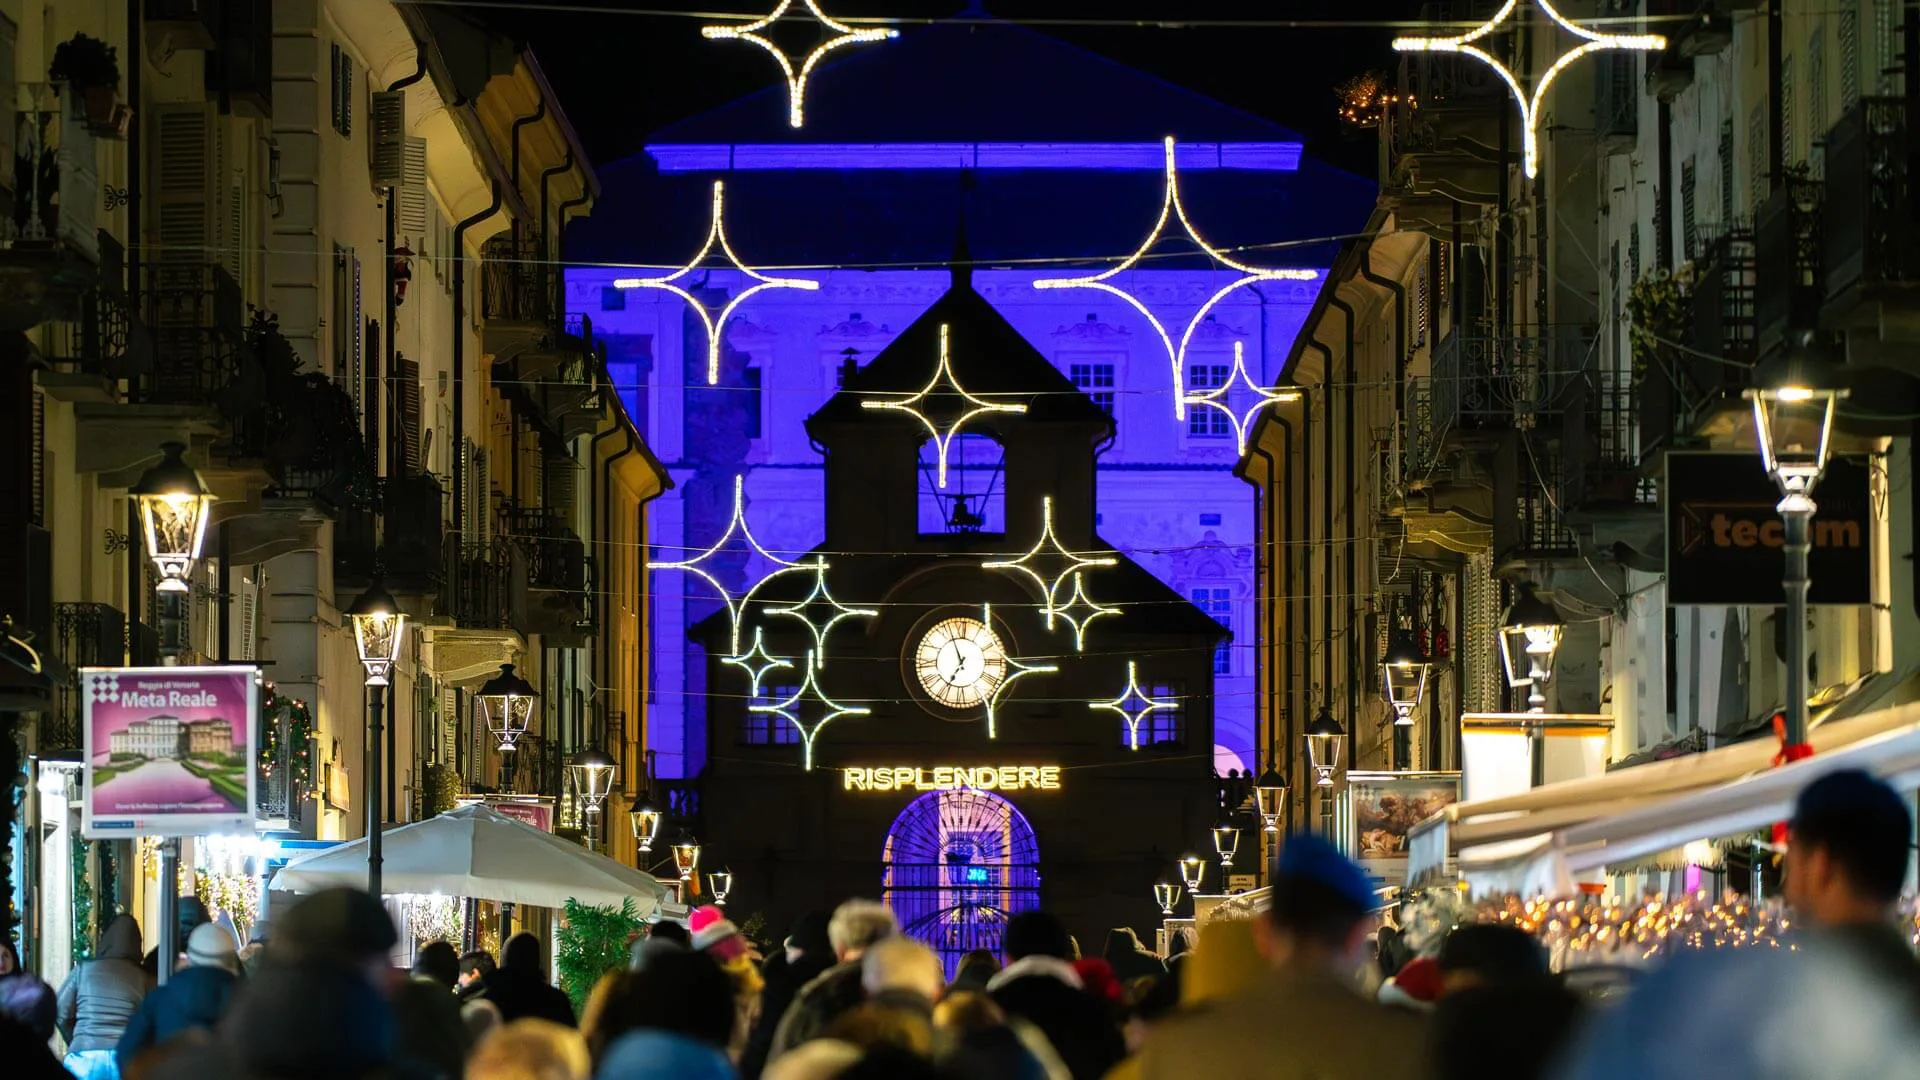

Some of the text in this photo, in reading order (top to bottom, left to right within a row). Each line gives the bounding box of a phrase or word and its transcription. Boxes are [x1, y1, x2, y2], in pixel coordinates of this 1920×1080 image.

[1711, 513, 1860, 547] tecm
[121, 690, 217, 708] Meta Reale
[844, 766, 1061, 791] RISPLENDERE
